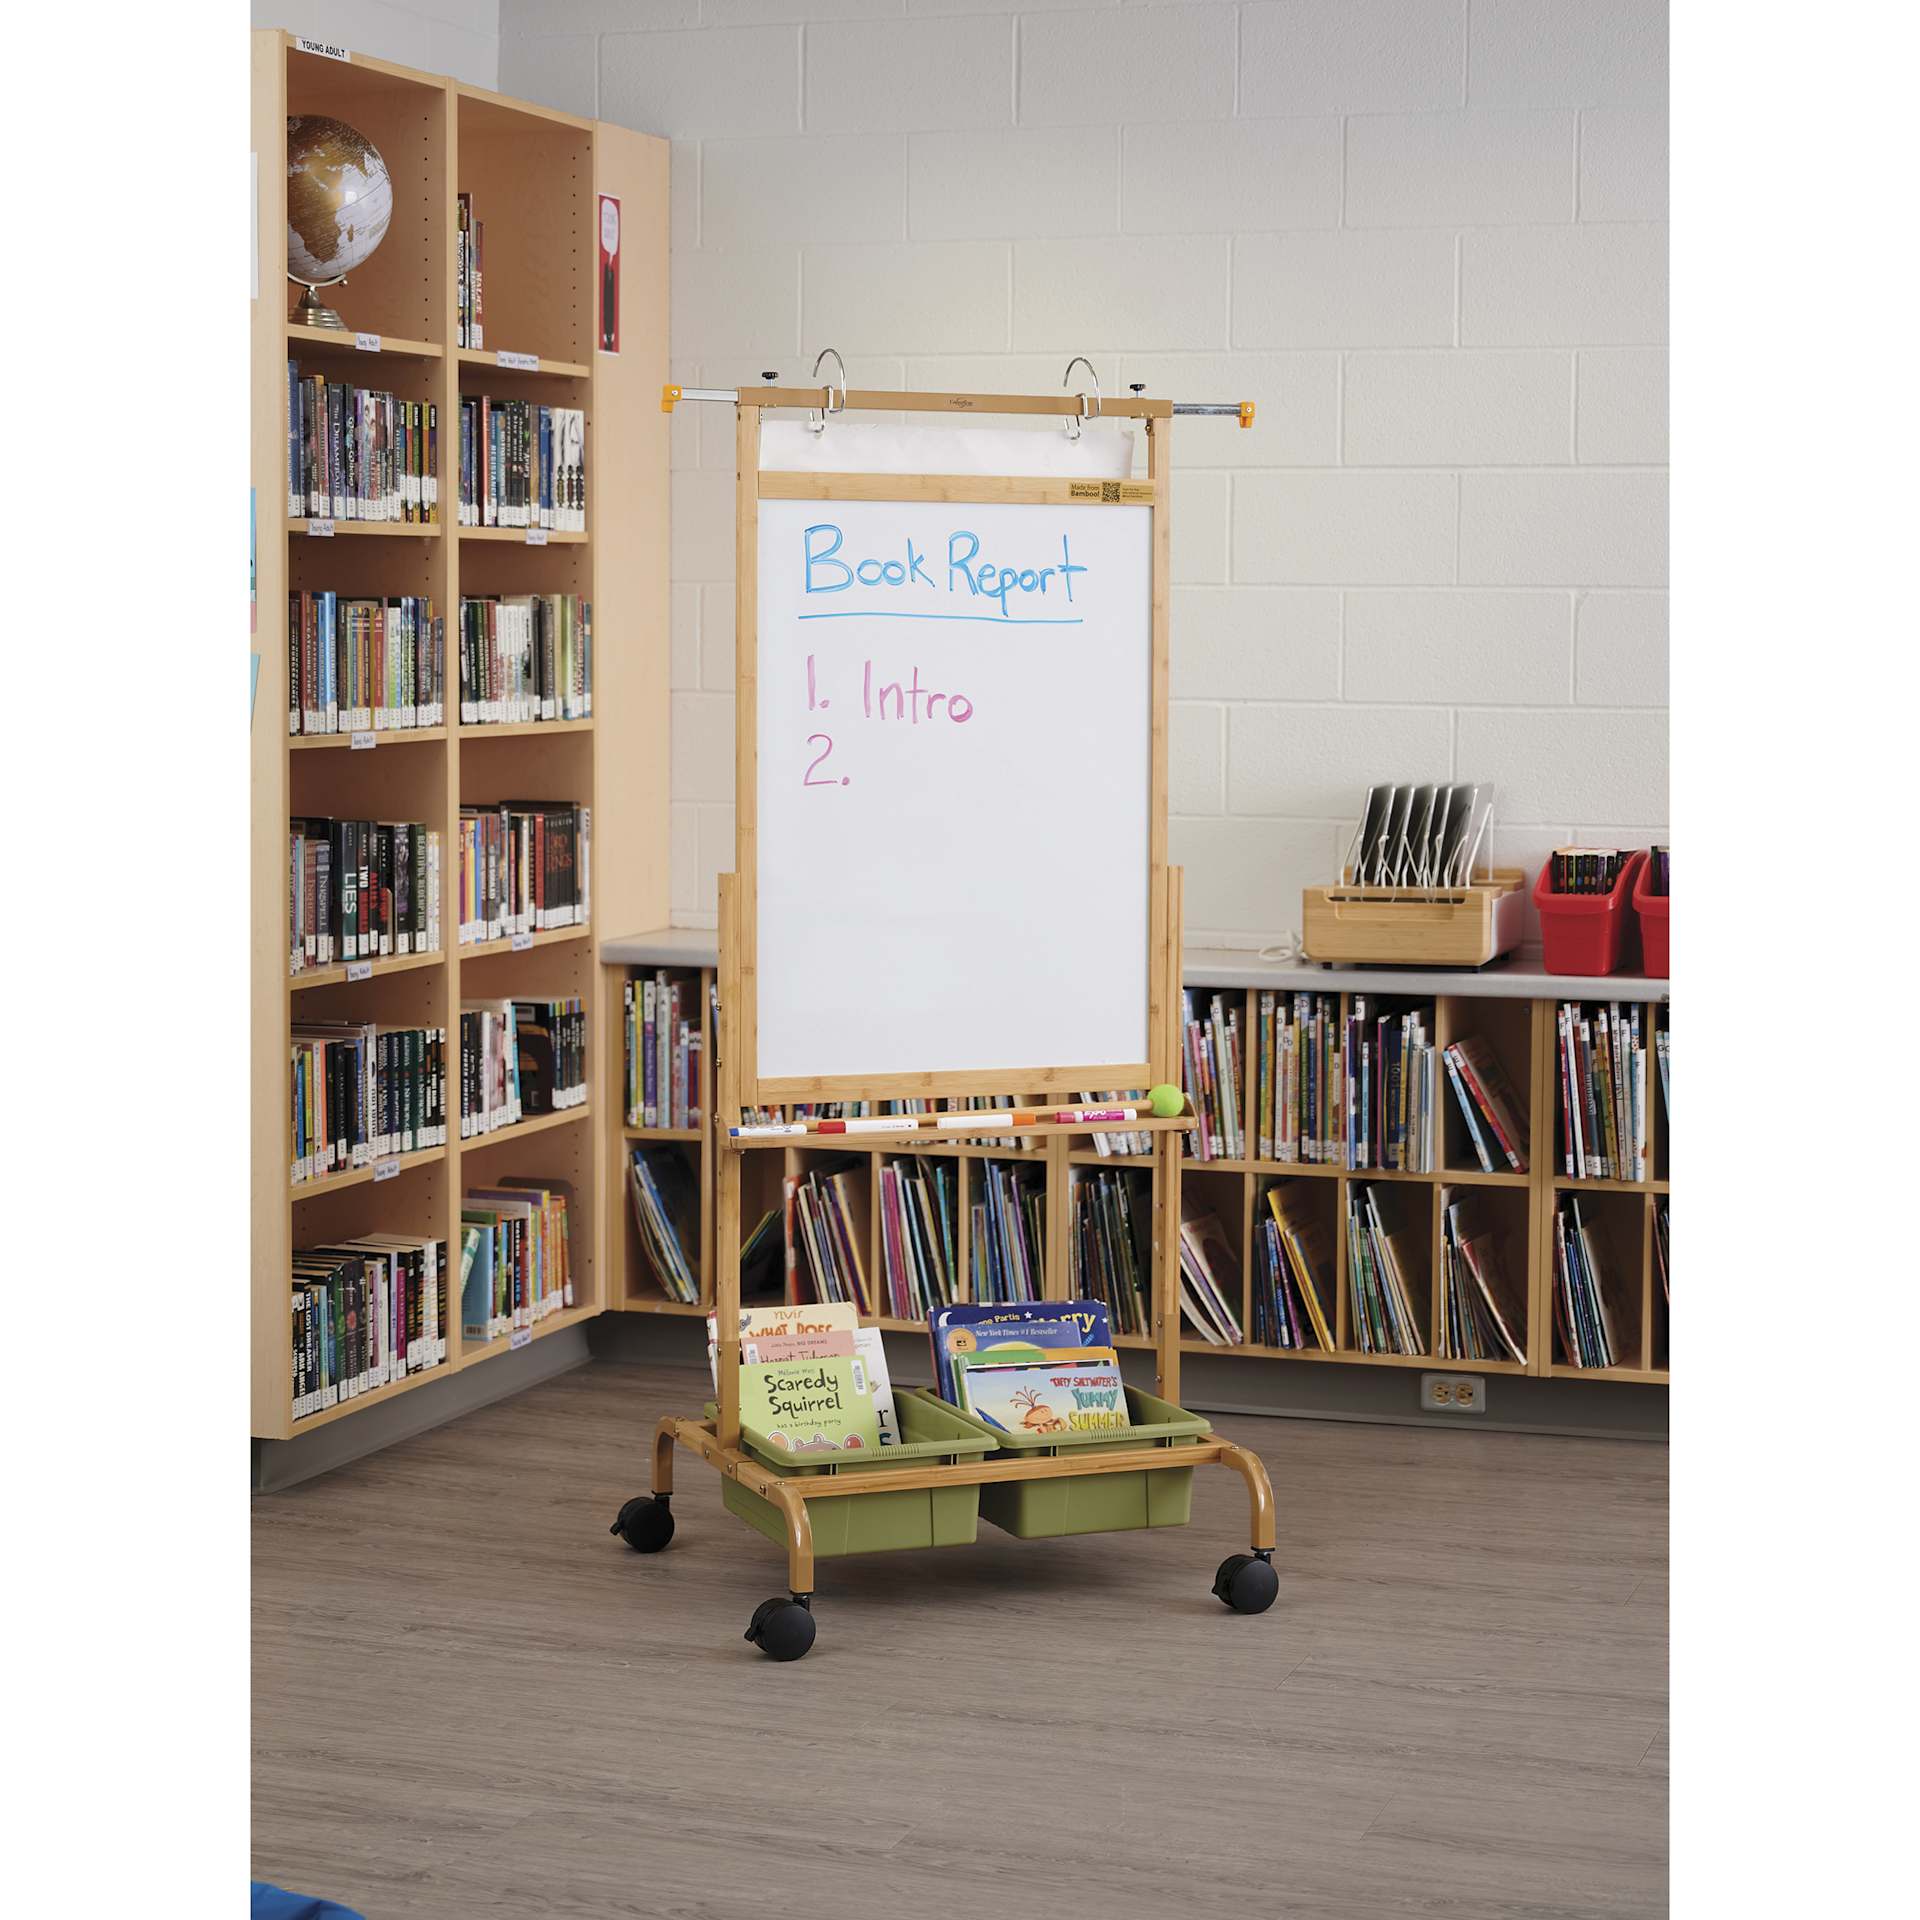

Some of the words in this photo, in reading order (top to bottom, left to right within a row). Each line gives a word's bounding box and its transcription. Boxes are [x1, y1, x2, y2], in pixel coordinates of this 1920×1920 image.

[302, 40, 324, 53] YOUNG
[325, 46, 345, 58] ADULT
[804, 524, 935, 594] Book
[948, 530, 1088, 617] Report
[807, 654, 830, 711] 1.
[863, 659, 974, 724] Intro
[804, 733, 851, 786] 2.
[360, 865, 368, 888] TWO
[345, 873, 357, 914] LIES
[749, 1323, 788, 1337] WHAT
[1030, 1327, 1058, 1335] Bestseller
[764, 1368, 839, 1394] Scaredy
[768, 1392, 843, 1419] Squirrel
[1071, 1388, 1119, 1411] YUMMY
[1068, 1411, 1125, 1431] SUMMER
